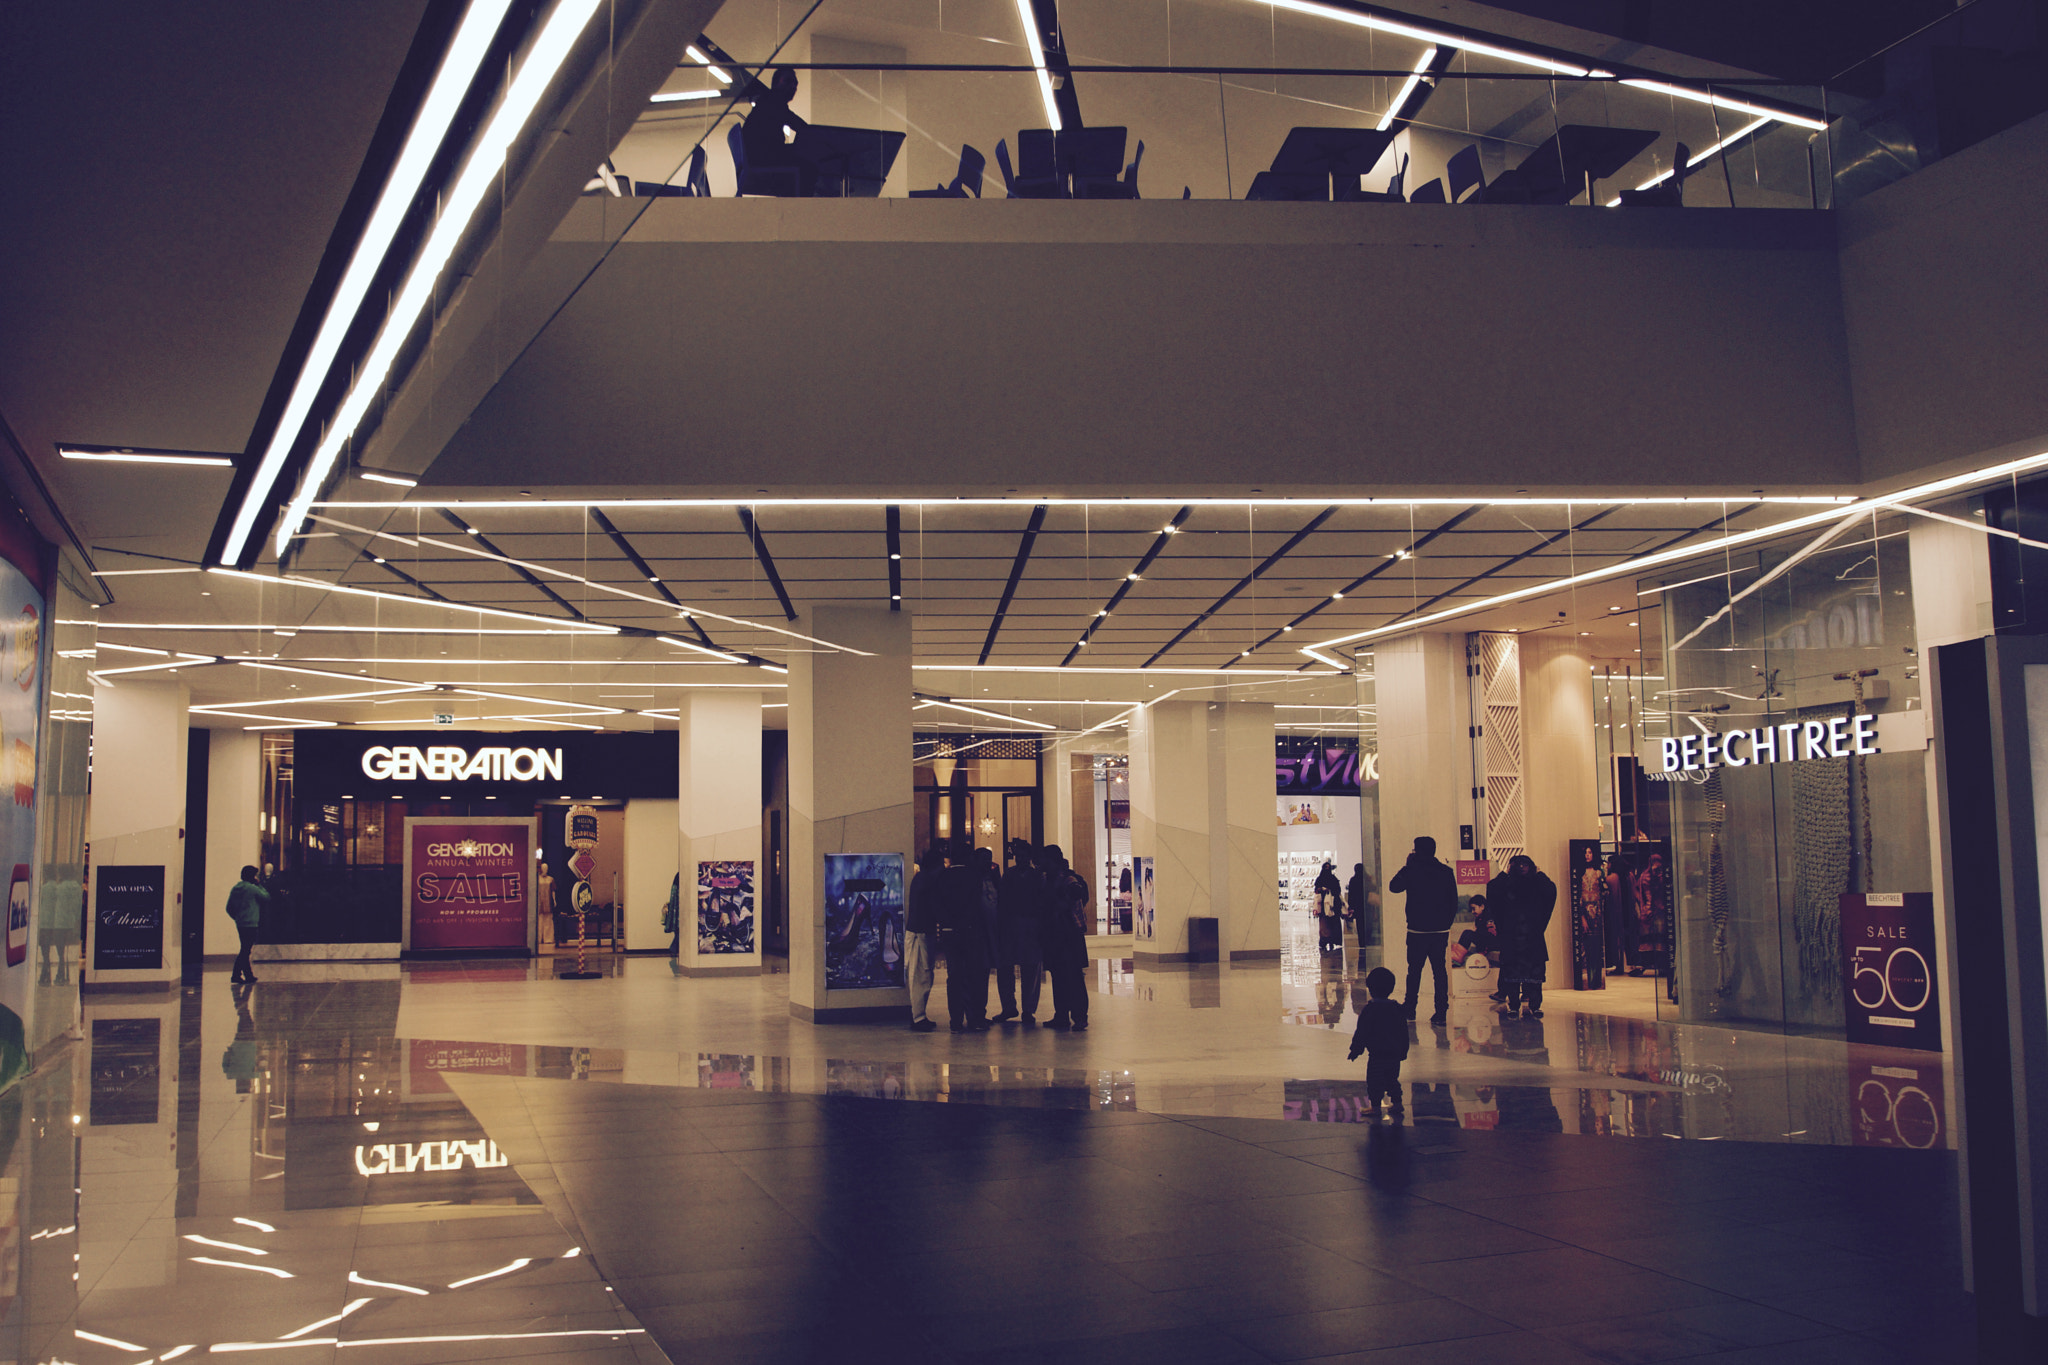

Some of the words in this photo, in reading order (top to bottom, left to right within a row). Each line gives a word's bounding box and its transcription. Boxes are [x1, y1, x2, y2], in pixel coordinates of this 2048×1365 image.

[1662, 714, 1878, 772] BEECHTREE
[361, 746, 563, 781] GENERATION
[427, 843, 513, 857] GENEATION
[427, 859, 470, 867] ANNUAL
[475, 858, 514, 866] WINTER
[1461, 868, 1485, 877] SALE
[416, 871, 522, 904] SALE
[1868, 894, 1900, 902] BEECHTREE
[101, 910, 150, 926] Ethnic
[1867, 925, 1907, 939] SALE
[1853, 946, 1931, 1012] 50
